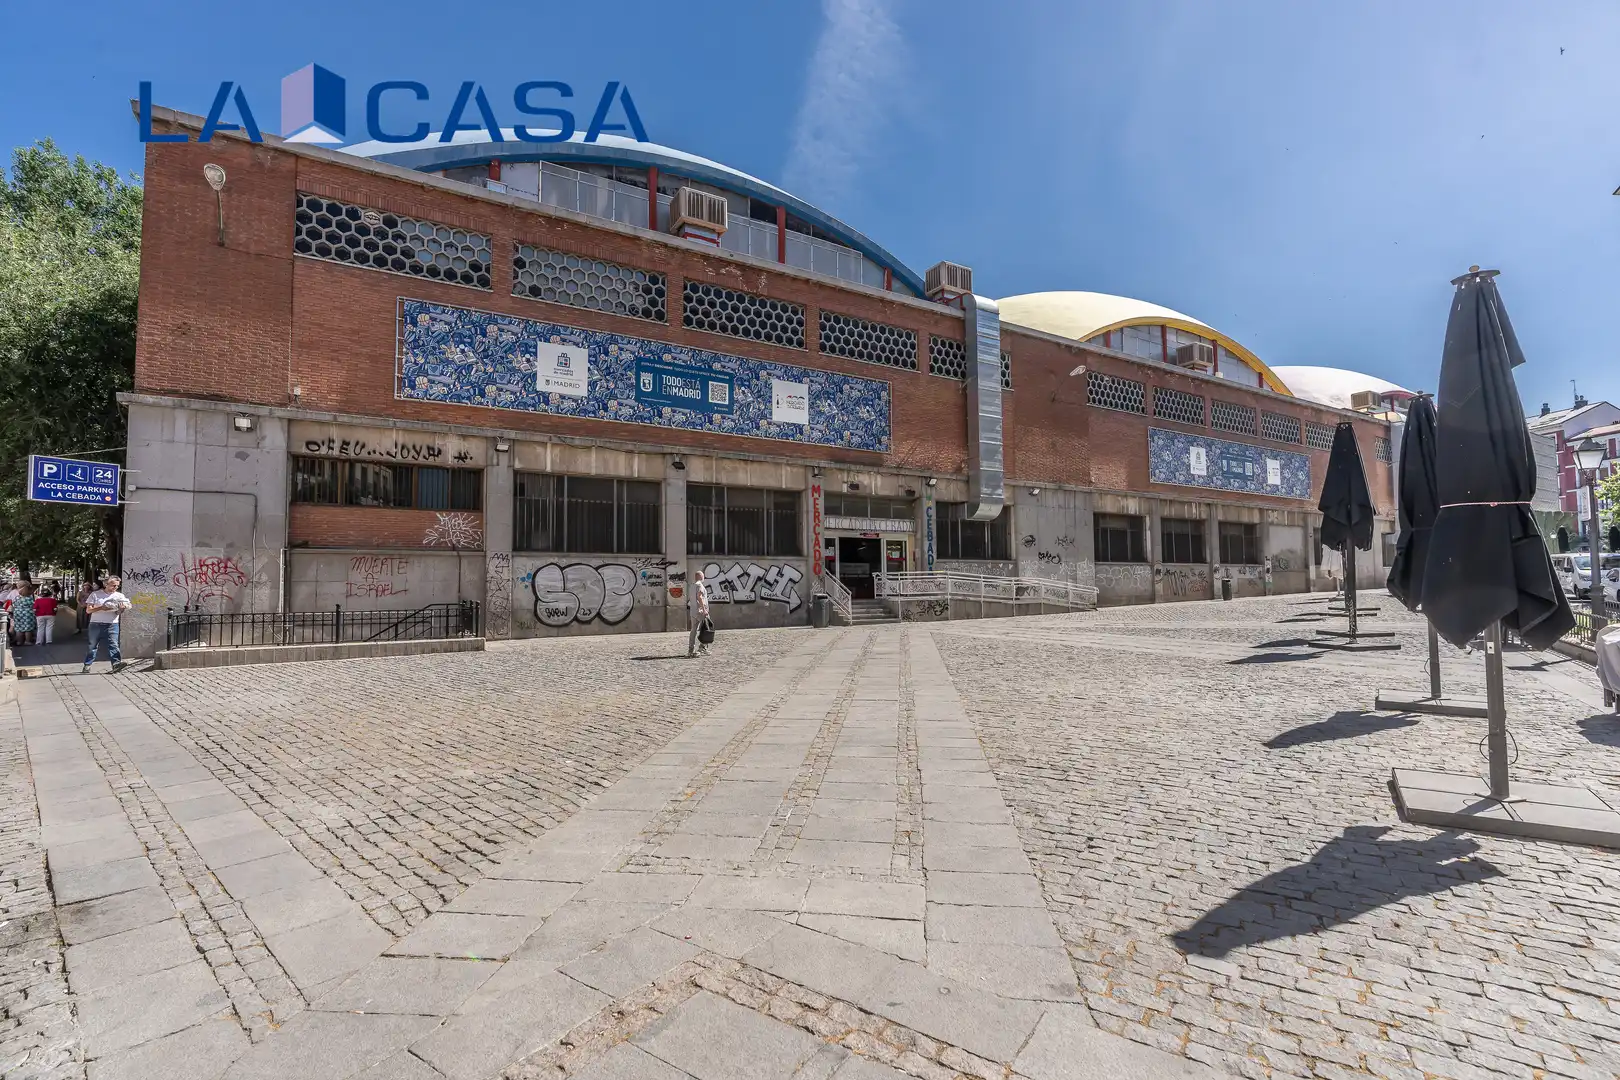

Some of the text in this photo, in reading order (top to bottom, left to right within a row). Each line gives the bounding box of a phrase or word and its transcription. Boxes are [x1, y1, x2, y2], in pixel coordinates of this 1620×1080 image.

[553, 380, 581, 389] MADRID
[43, 463, 57, 477] P
[95, 469, 113, 479] 24
[38, 482, 114, 494] ACCESO PARKING
[65, 492, 102, 501] CEBADA
[811, 484, 822, 576] MERCADO
[350, 556, 409, 577] MUERTE
[345, 581, 409, 598] ISRAEL
